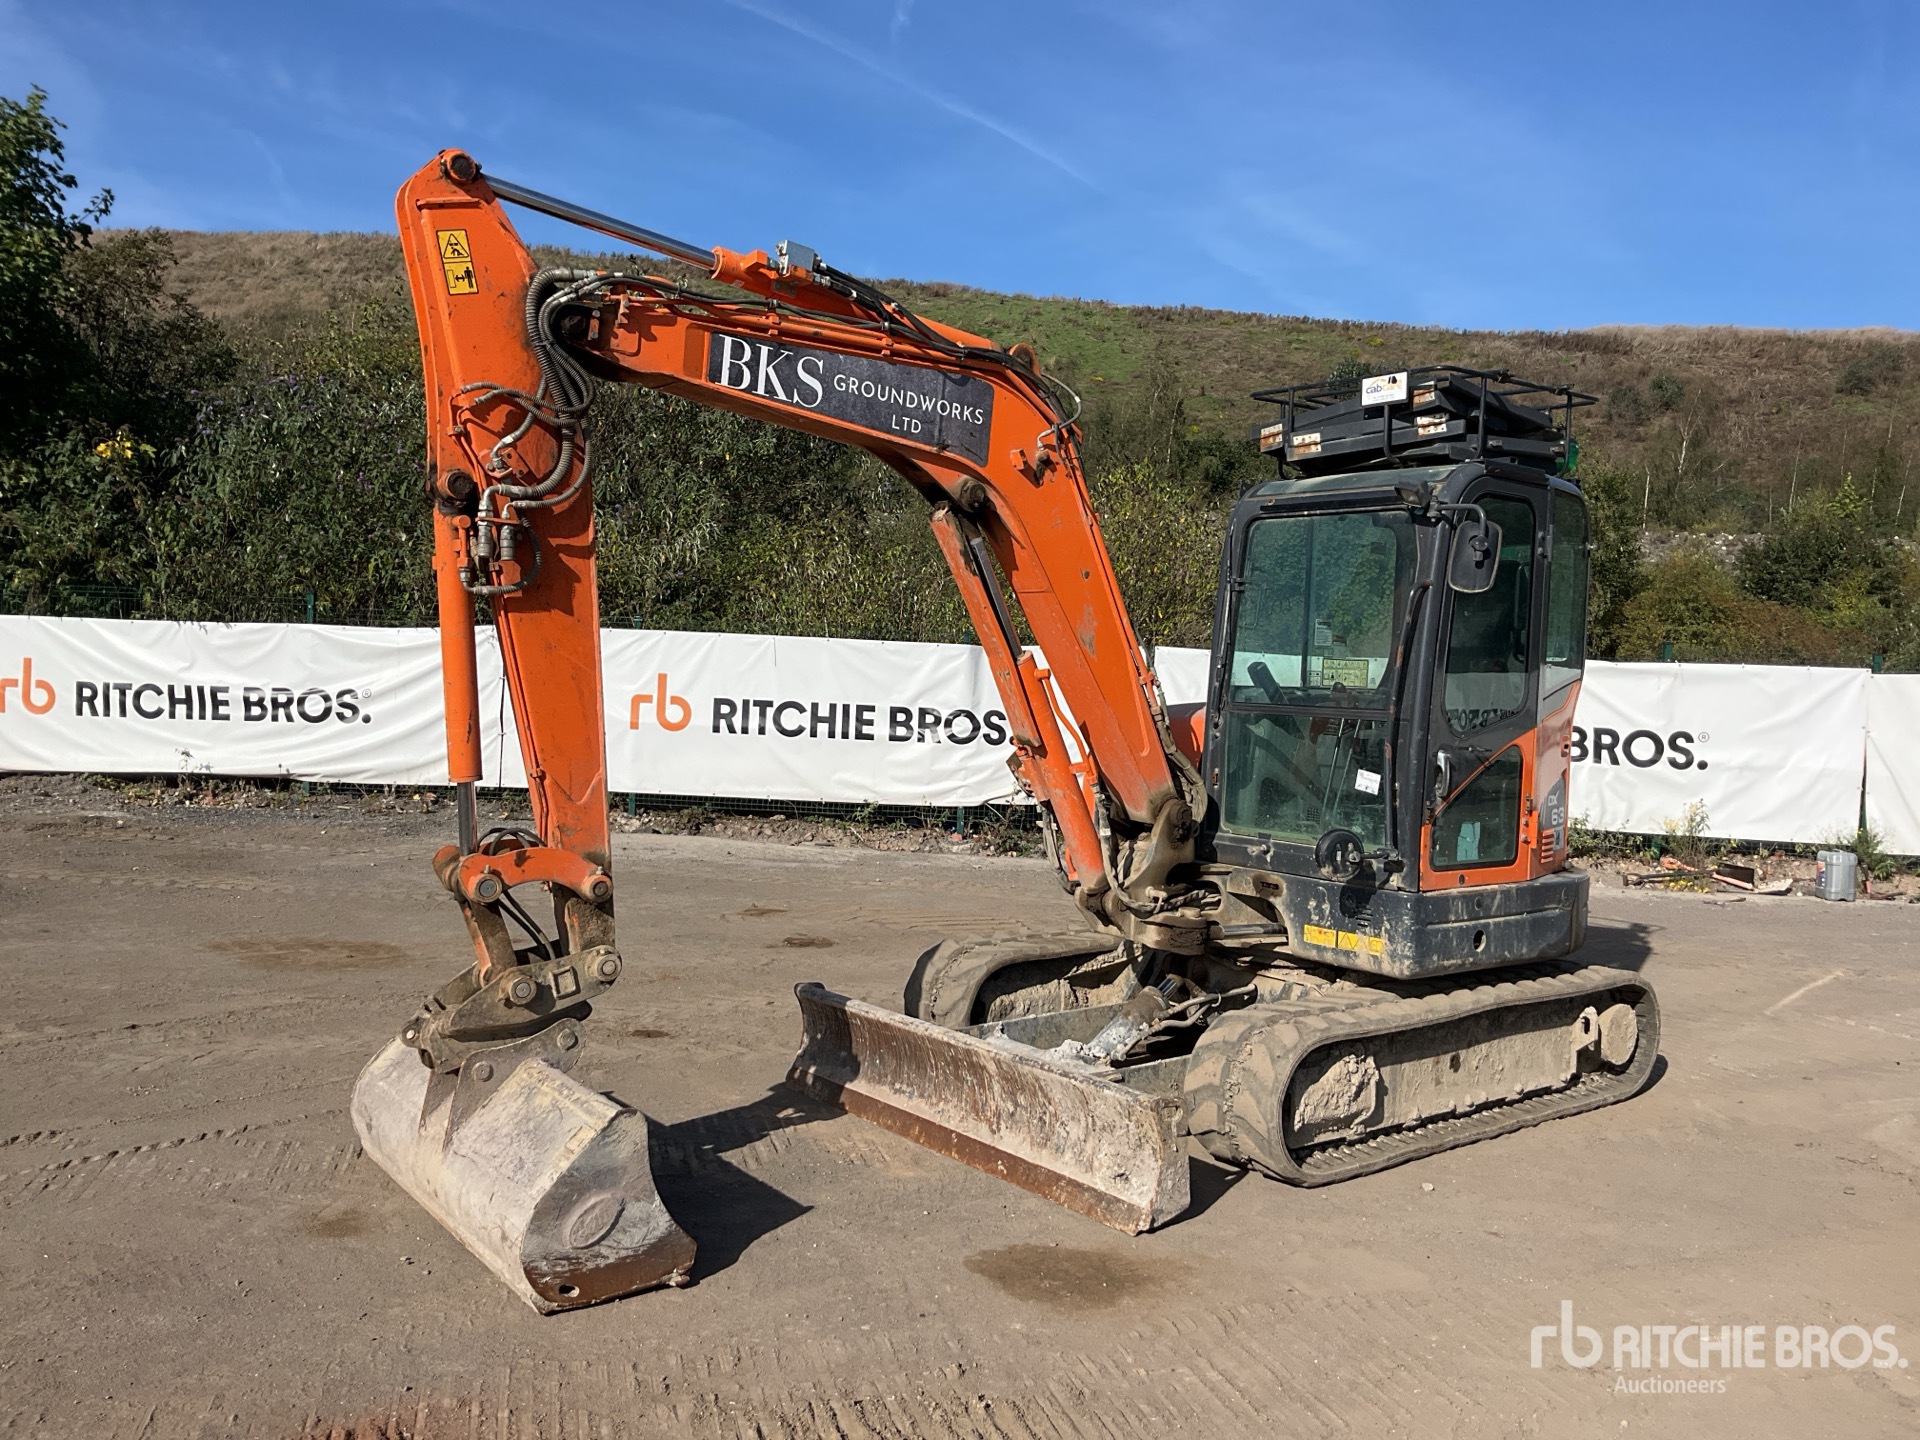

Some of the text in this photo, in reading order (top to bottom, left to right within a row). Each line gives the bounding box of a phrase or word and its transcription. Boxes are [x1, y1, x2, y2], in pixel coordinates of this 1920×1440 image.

[715, 334, 984, 426] BKS GROUNDWORKS
[891, 414, 922, 434] LTD
[75, 680, 231, 722] RITCHIE
[243, 686, 372, 725] BROS.
[629, 672, 692, 732] rb
[712, 697, 877, 741] RITCHIE
[1551, 806, 1565, 826] 63
